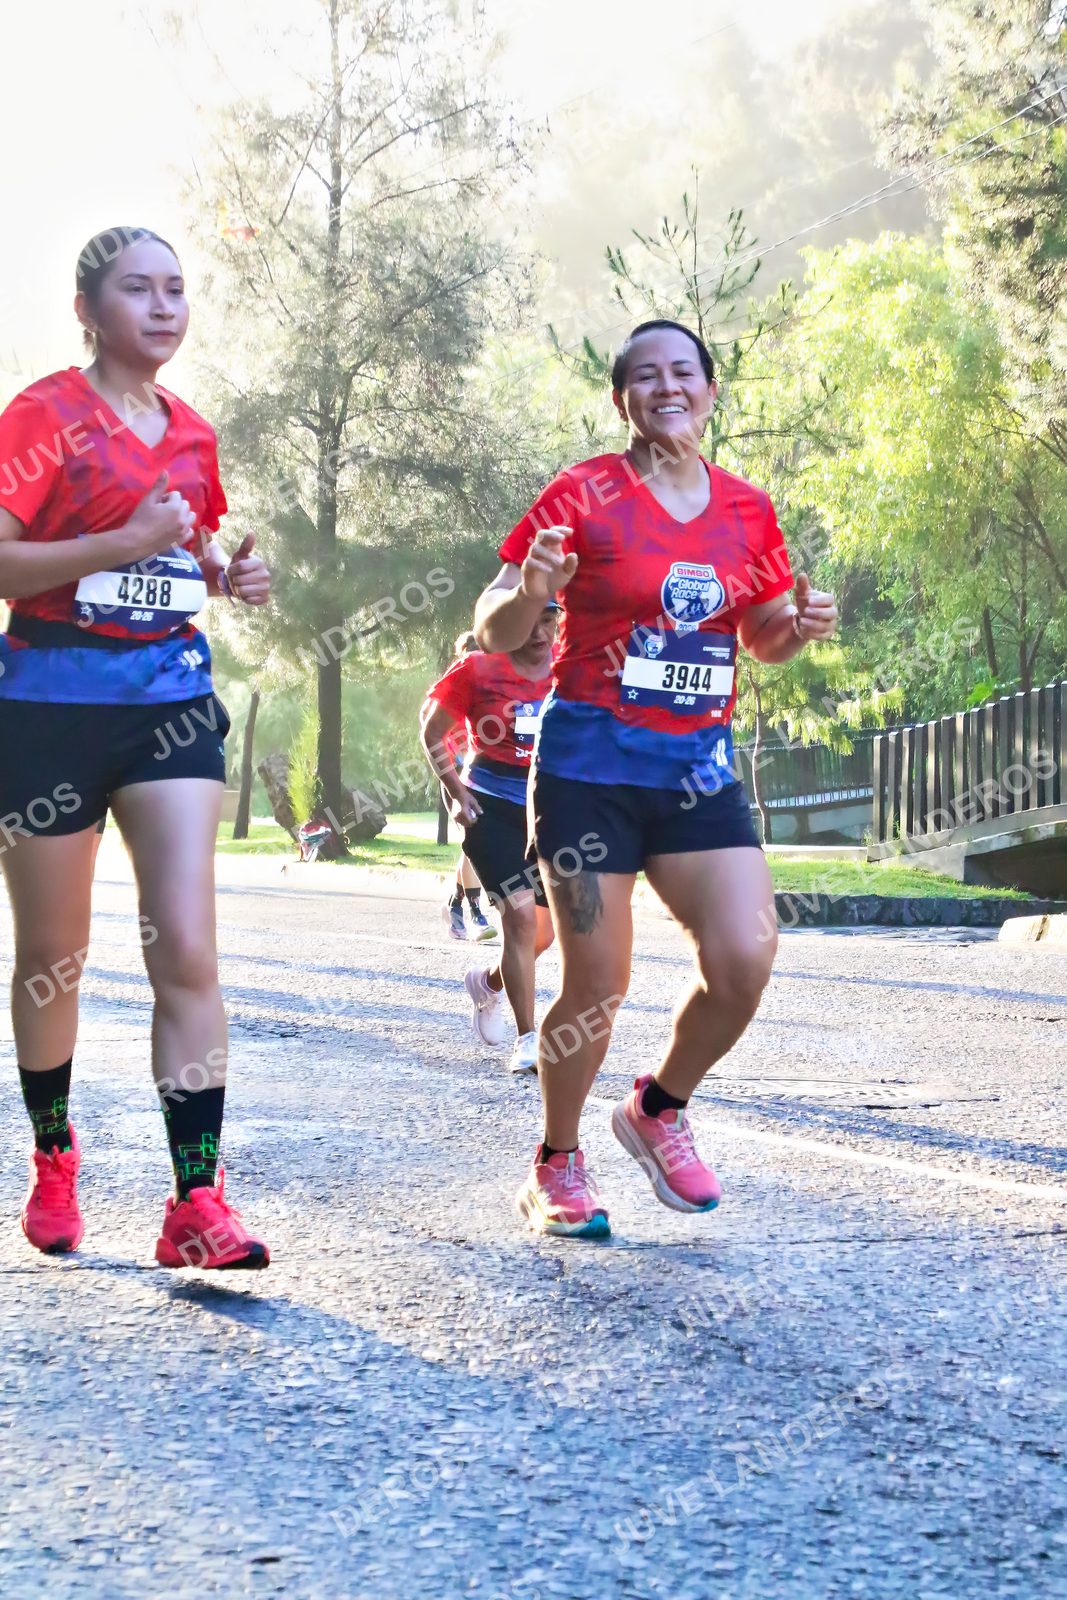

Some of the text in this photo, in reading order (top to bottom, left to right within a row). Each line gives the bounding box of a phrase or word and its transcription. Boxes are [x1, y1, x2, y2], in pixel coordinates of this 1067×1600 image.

[677, 568, 710, 577] BIMBO
[117, 575, 171, 607] 4288
[678, 580, 710, 592] Global
[671, 588, 698, 599] Race
[662, 664, 712, 692] 3944
